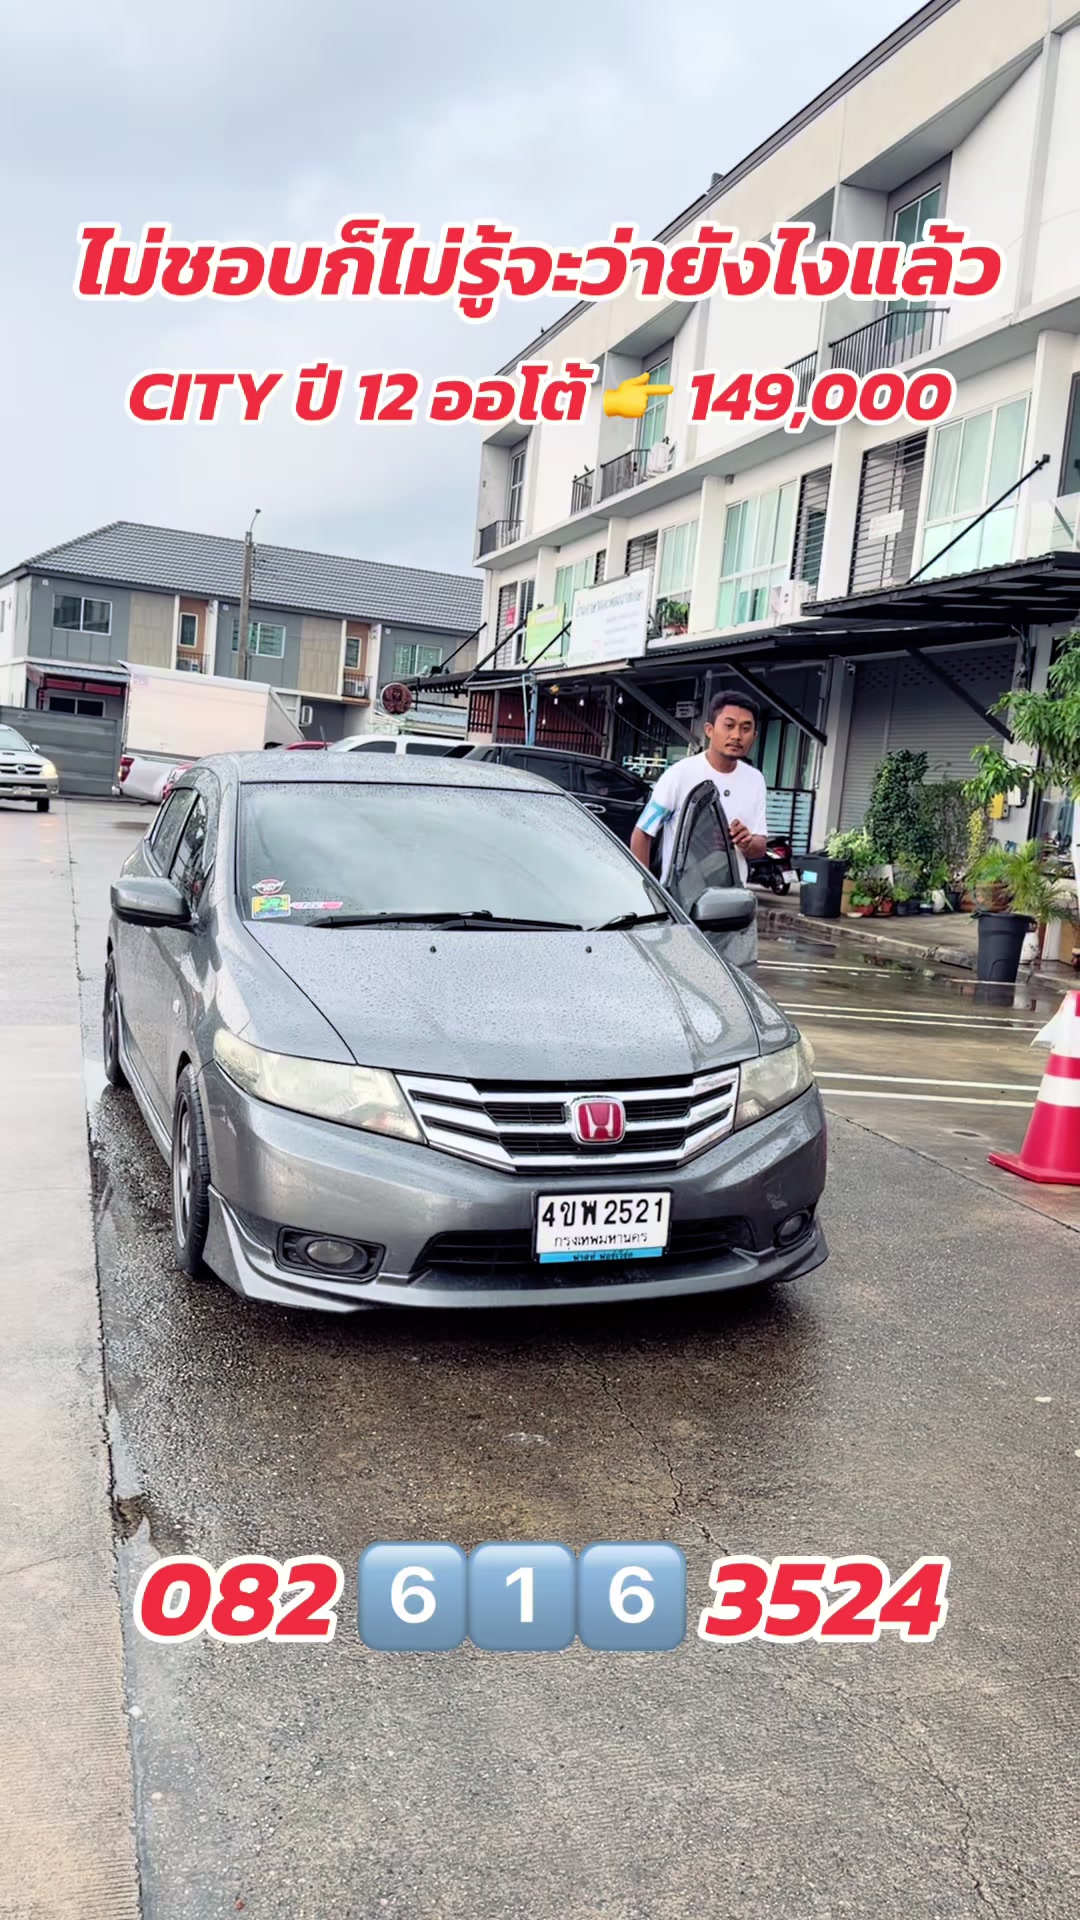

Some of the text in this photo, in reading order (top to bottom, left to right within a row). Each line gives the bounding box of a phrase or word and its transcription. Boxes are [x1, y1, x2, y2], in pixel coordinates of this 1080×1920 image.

[604, 1198, 663, 1225] 2521
[554, 1232, 648, 1250] กรุงเทพมหานคร
